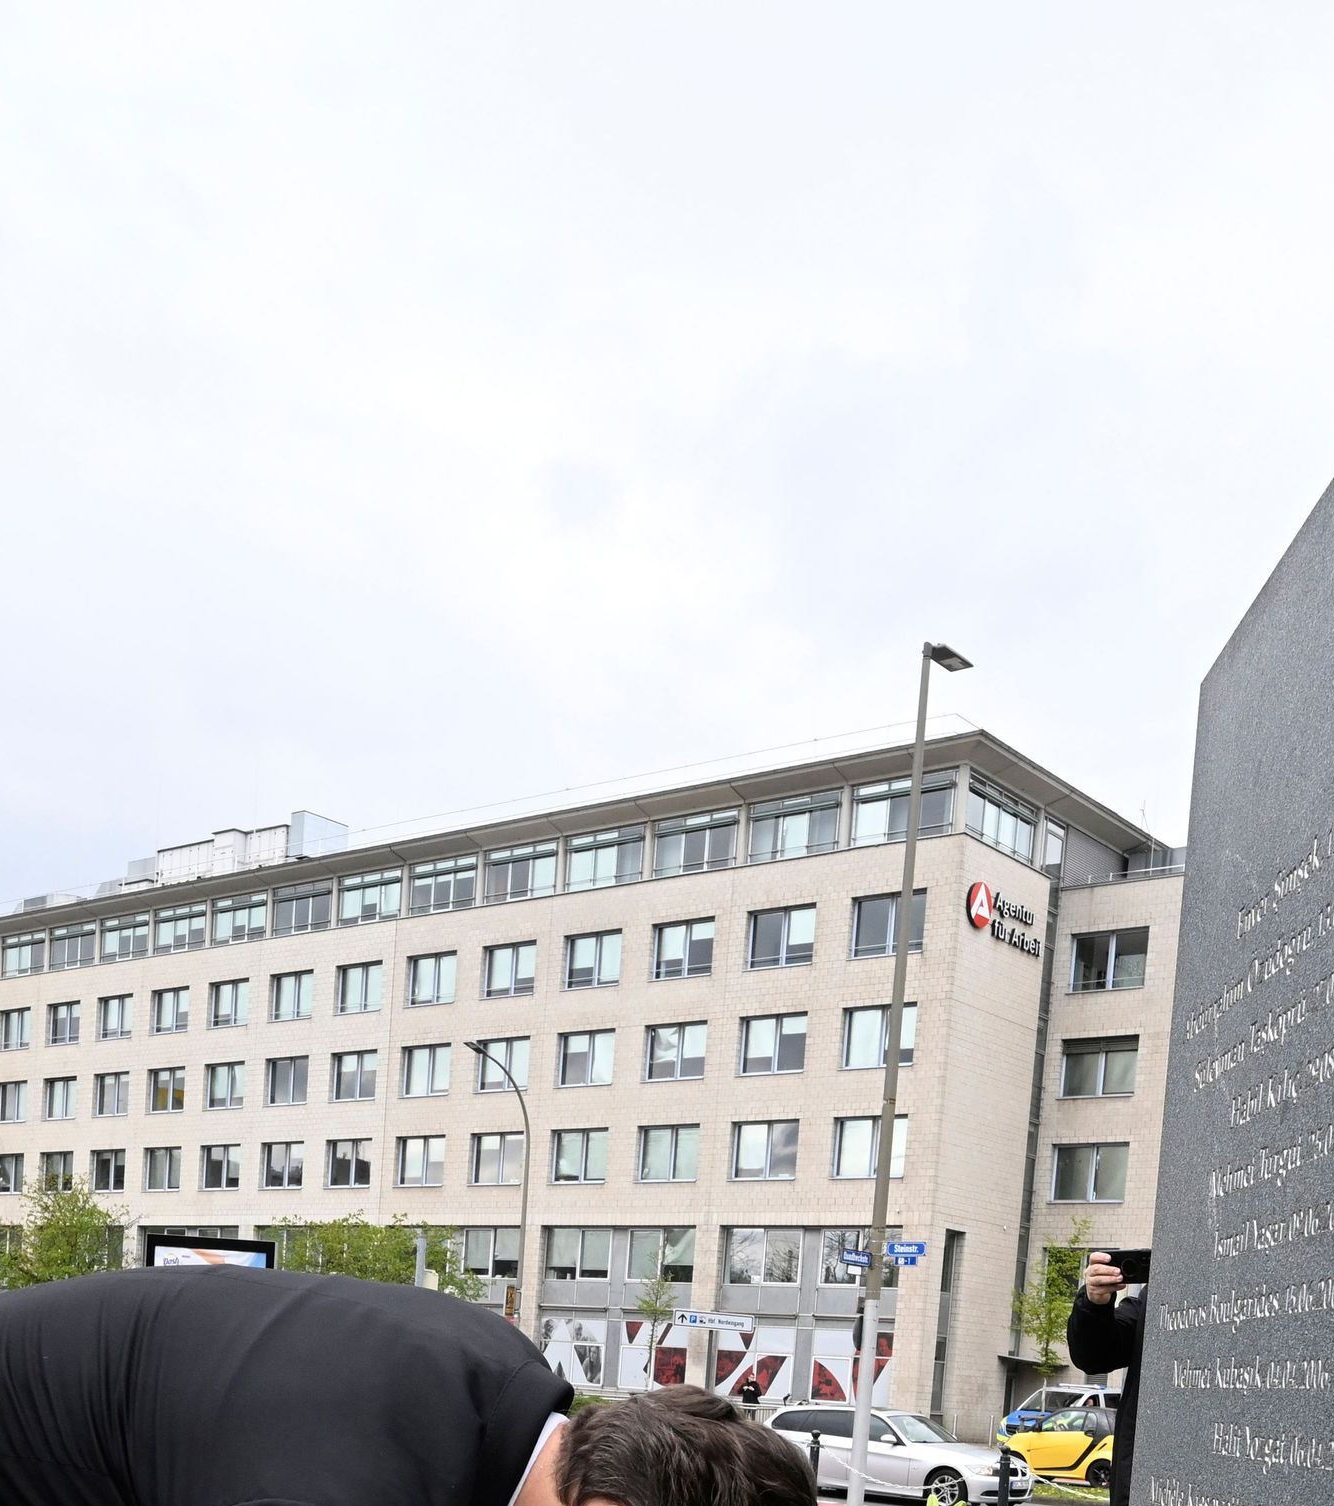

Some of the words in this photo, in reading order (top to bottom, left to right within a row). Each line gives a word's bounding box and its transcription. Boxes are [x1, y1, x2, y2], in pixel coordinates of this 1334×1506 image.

[995, 892, 1035, 926] Agentur
[1236, 896, 1269, 940] Enver
[992, 918, 1010, 943] für
[1010, 928, 1041, 958] Arbeit
[1193, 1039, 1245, 1093] Süleyman
[1230, 1081, 1264, 1128] Habil
[1208, 1158, 1255, 1199] Mehmet
[718, 1319, 744, 1328] Nordeingang
[1157, 1303, 1207, 1332] Theodoros
[1171, 1360, 1212, 1389] Mehmet
[1212, 1423, 1242, 1459] Halit
